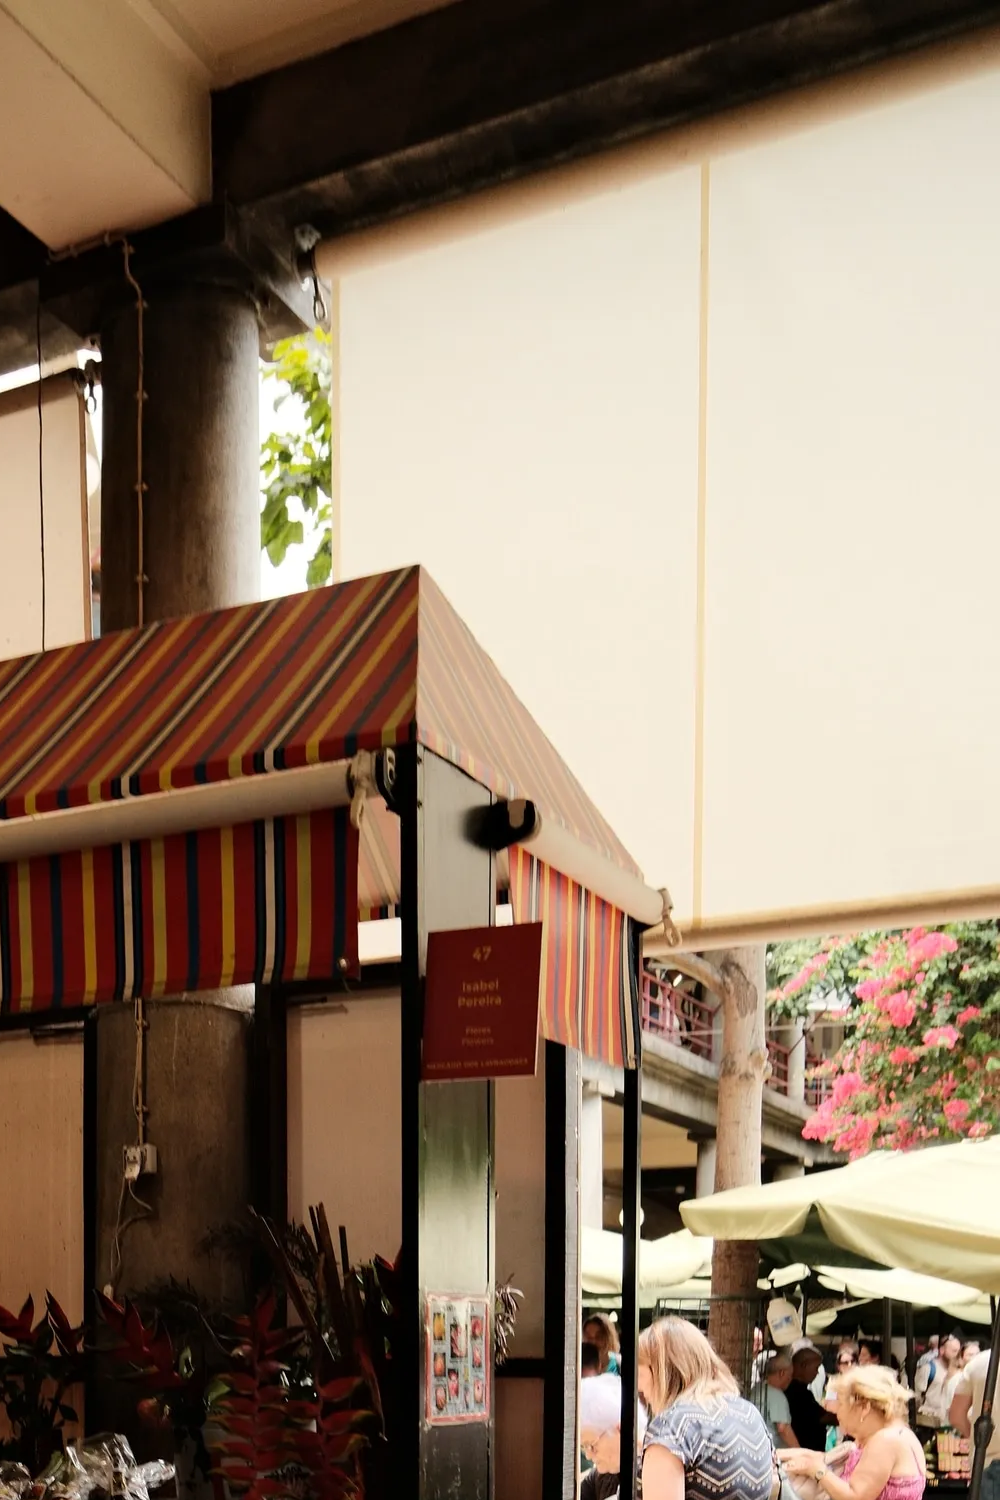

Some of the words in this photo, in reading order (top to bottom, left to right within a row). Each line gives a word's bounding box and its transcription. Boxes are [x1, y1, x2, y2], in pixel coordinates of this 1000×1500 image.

[472, 945, 492, 962] 47
[462, 977, 499, 993] Isabel
[457, 995, 502, 1009] Pereira
